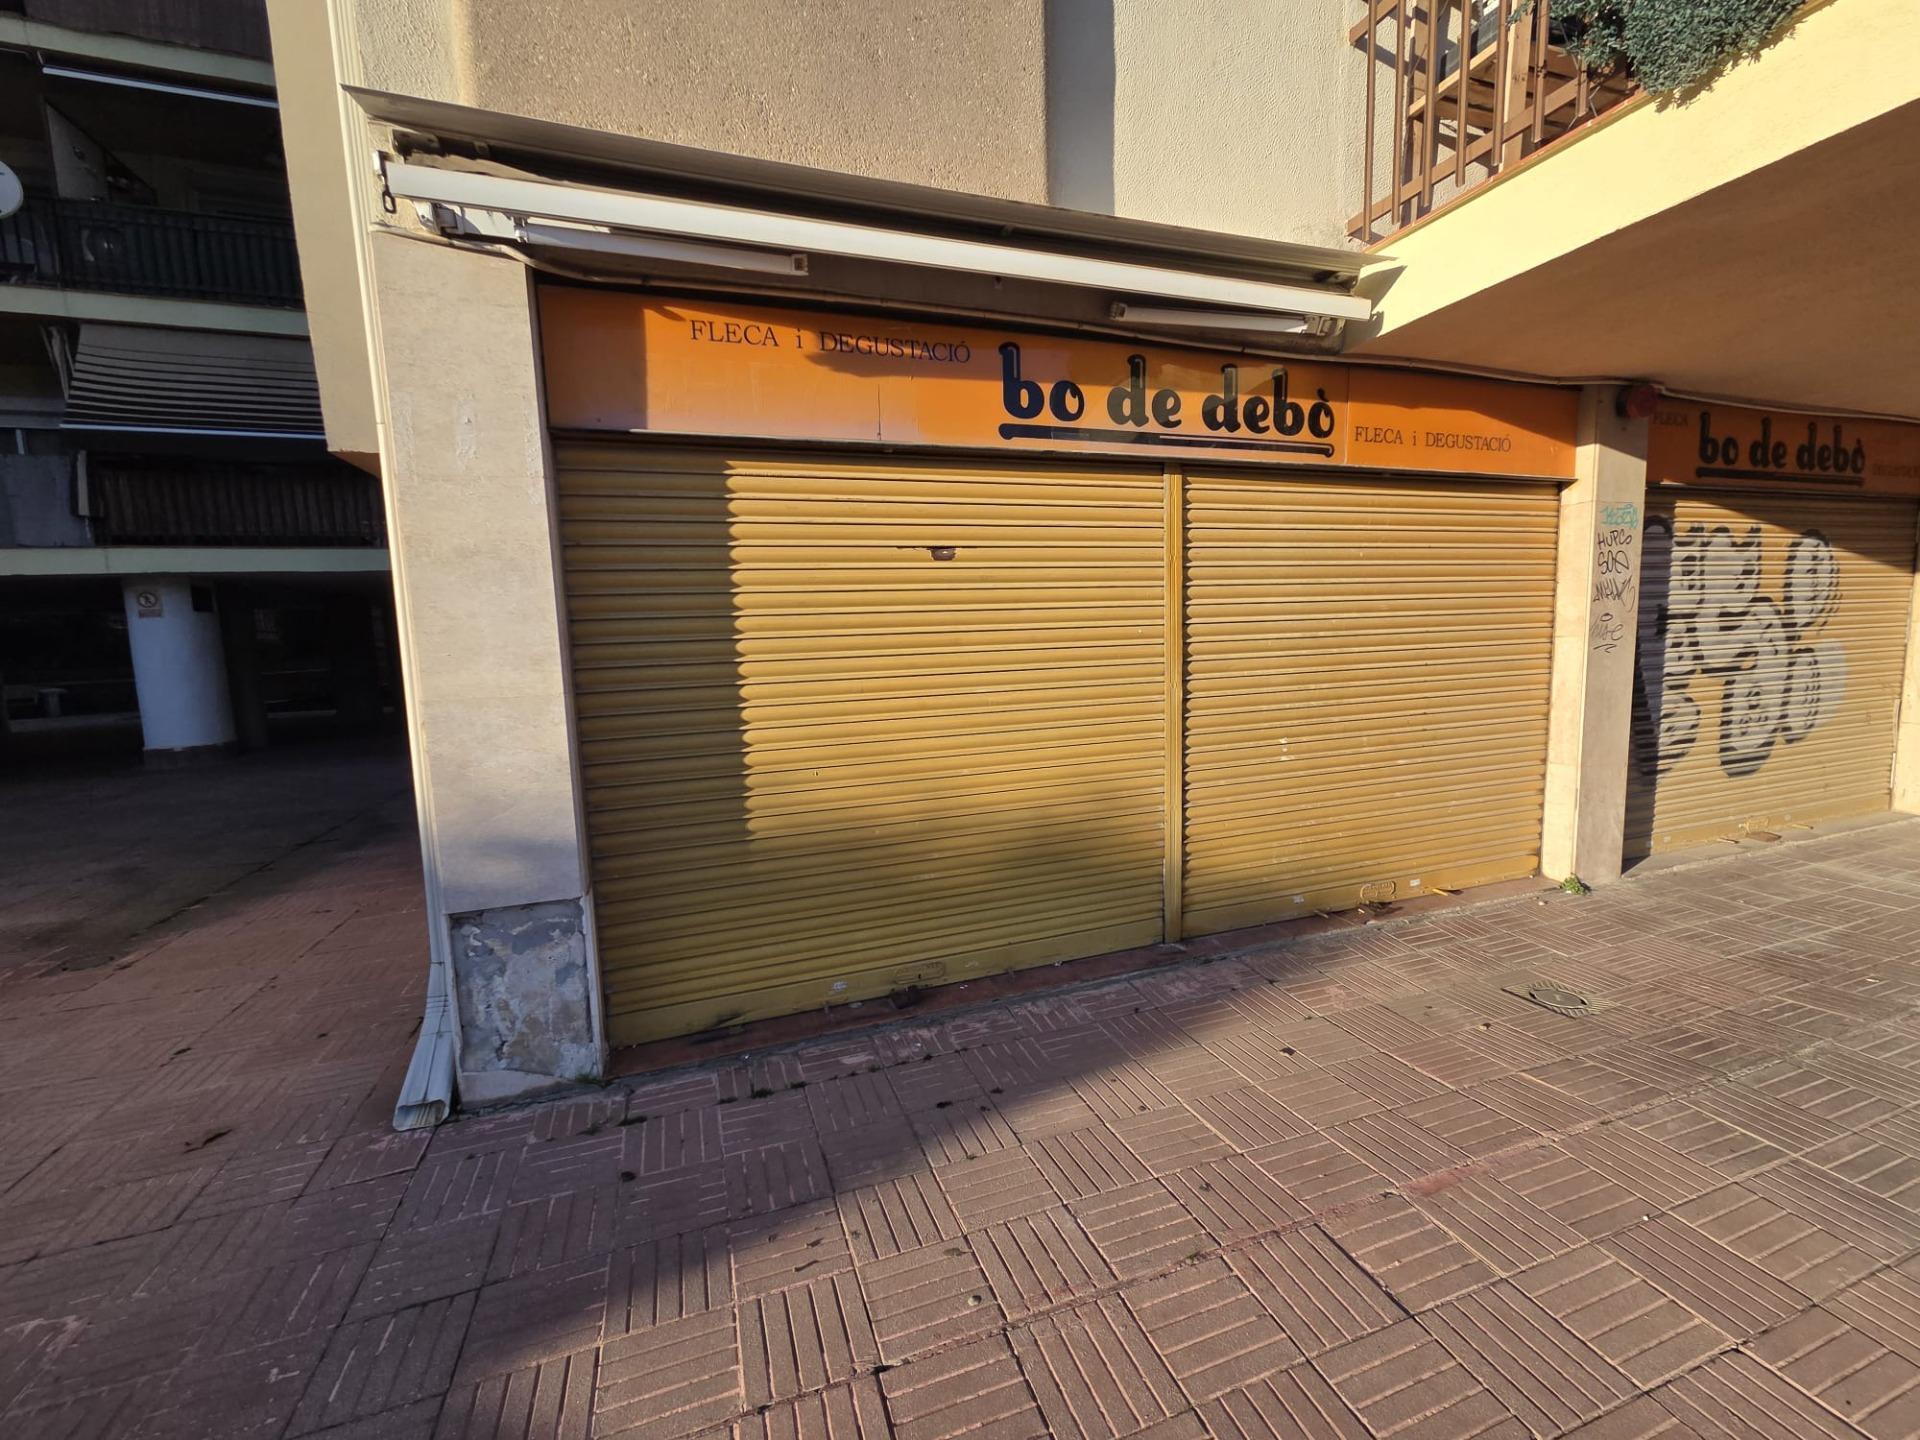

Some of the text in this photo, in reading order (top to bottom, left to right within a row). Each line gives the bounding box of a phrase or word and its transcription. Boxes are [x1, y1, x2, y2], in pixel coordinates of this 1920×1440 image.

[689, 319, 972, 364] FLECA i DEGUSTACIÓ
[998, 341, 1336, 439] bo de debò
[1354, 425, 1512, 453] FLECA i DEGUSTACIÓ
[1698, 410, 1866, 475] bo de debò
